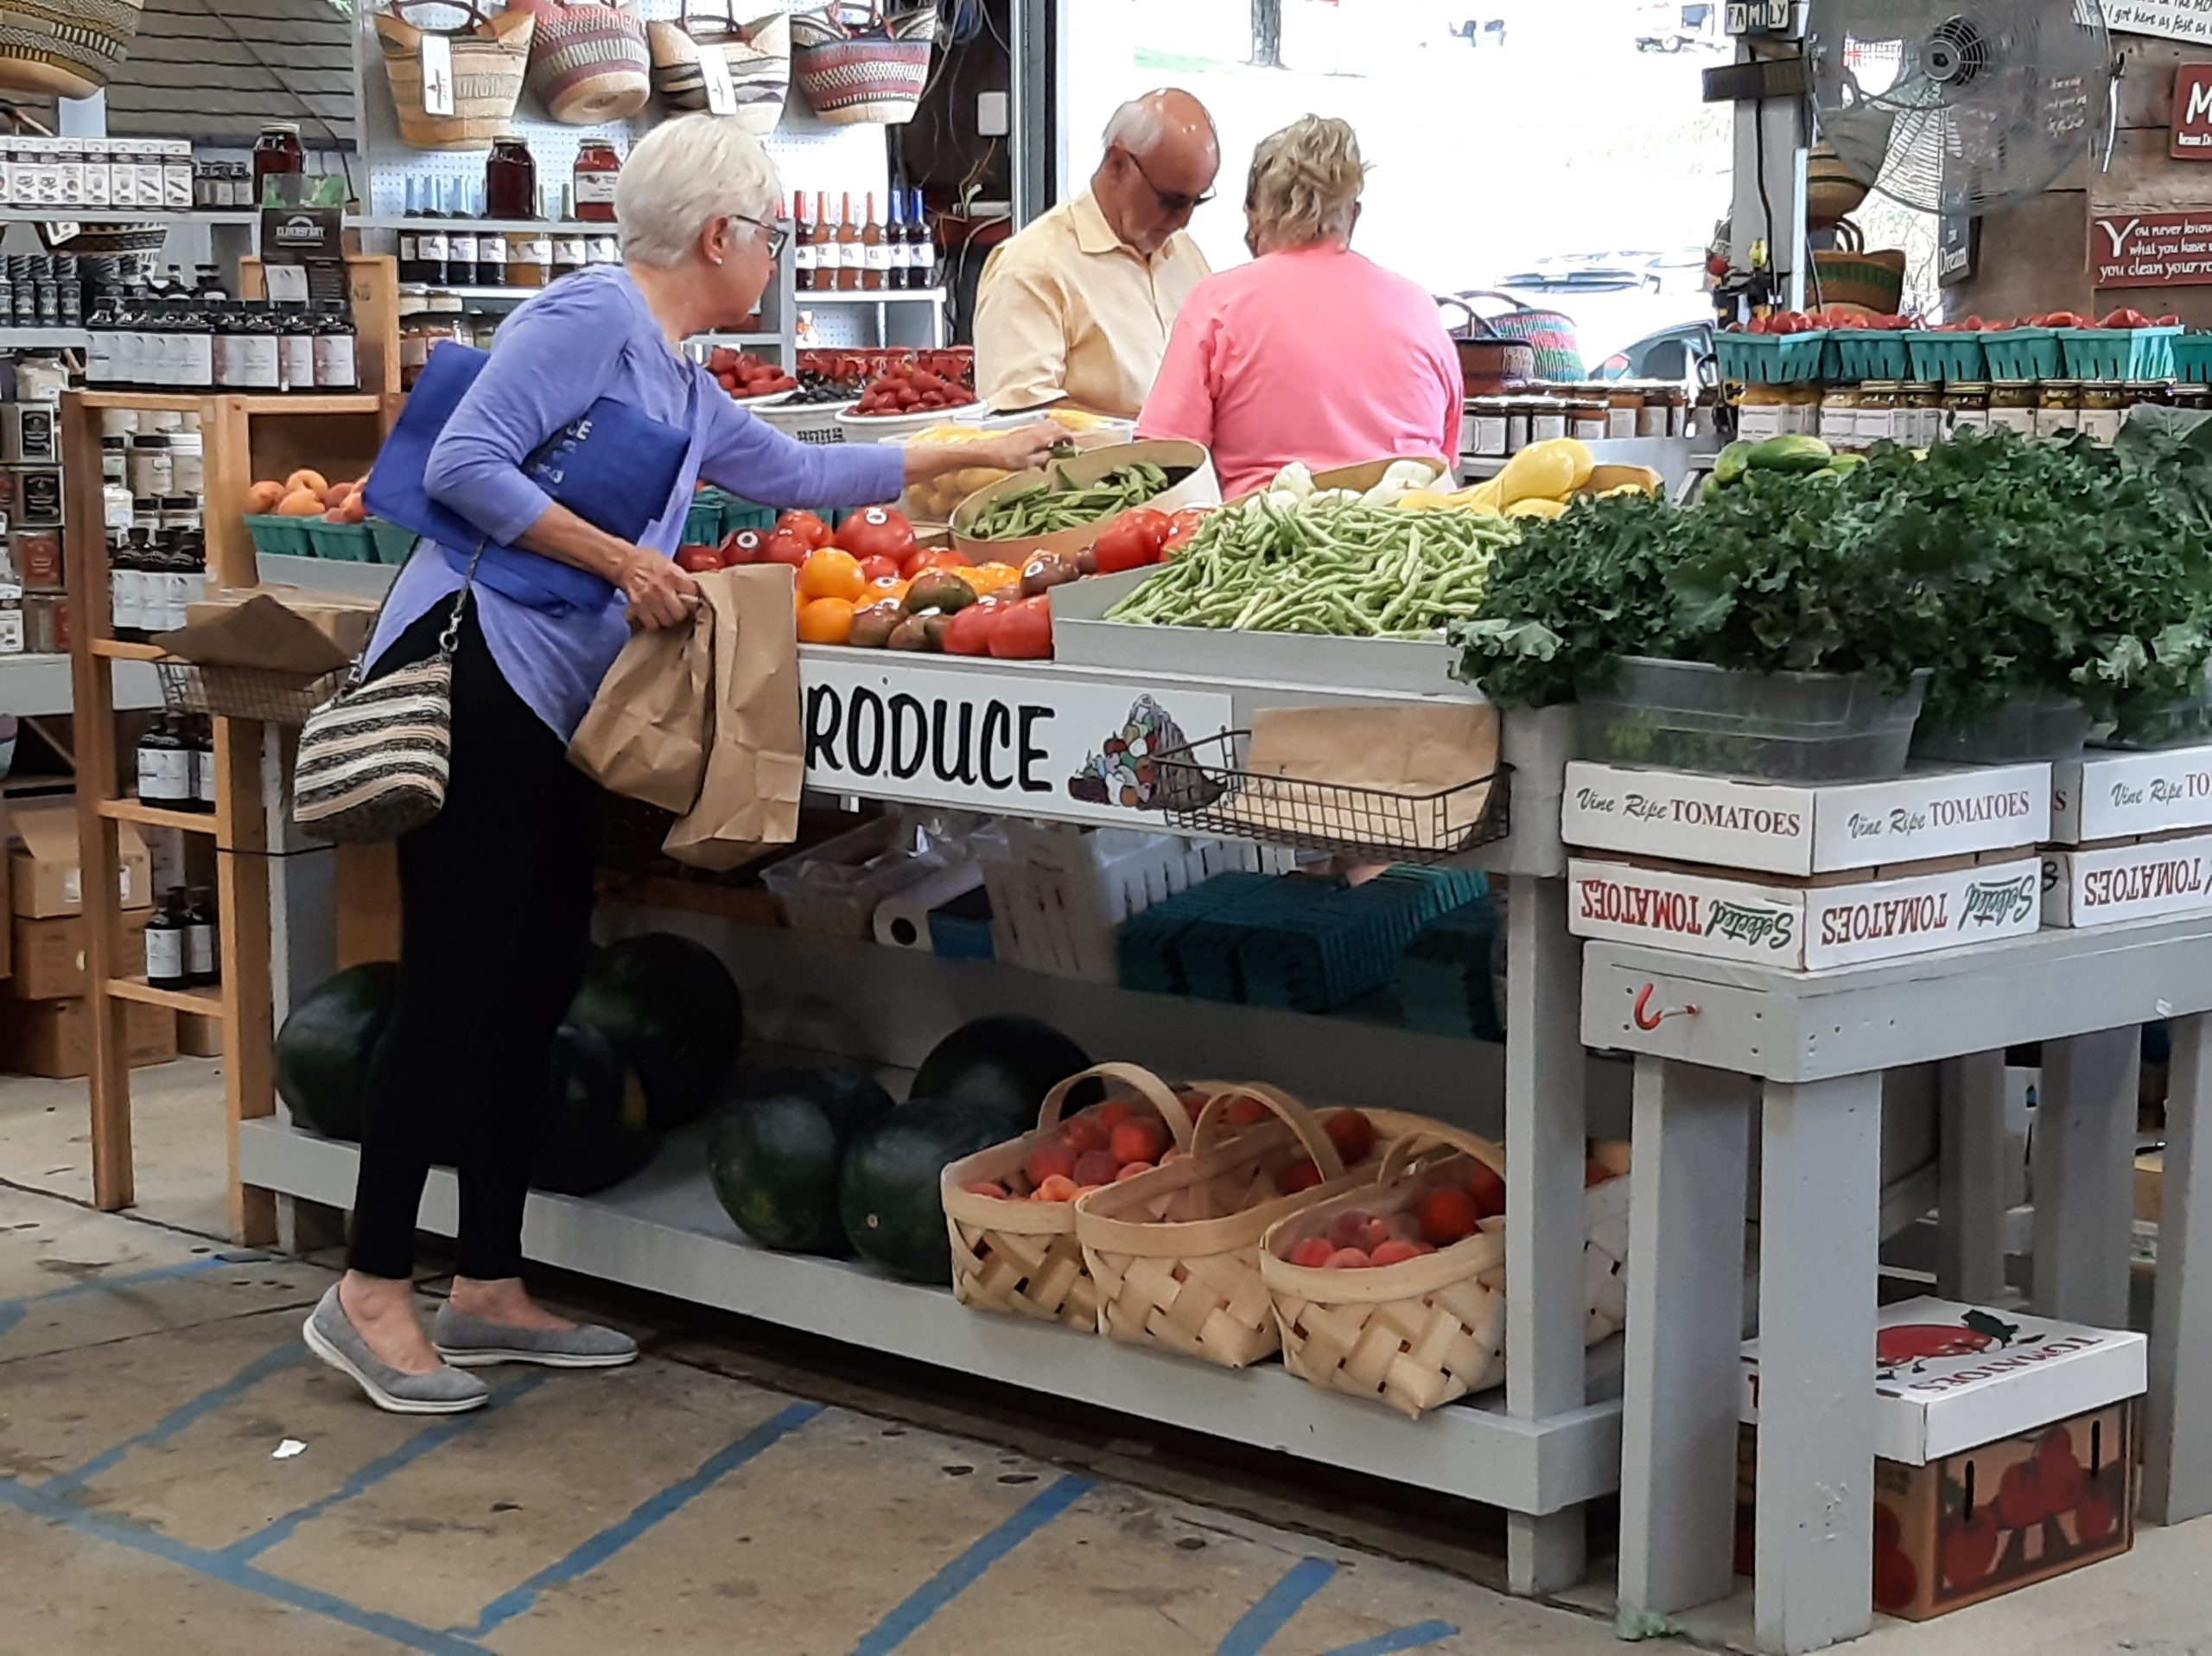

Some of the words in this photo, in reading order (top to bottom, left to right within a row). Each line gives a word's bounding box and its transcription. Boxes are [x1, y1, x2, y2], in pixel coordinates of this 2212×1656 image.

[1727, 3, 1786, 28] FAMILY
[2114, 6, 2132, 24] got
[2129, 239, 2157, 257] what
[2157, 243, 2178, 261] you
[2152, 225, 2183, 237] never
[1939, 246, 1967, 277] Dream
[2099, 264, 2125, 283] you
[2127, 257, 2164, 277] clean
[798, 683, 1055, 793] RODUCE
[1576, 787, 1614, 812] Vine
[1622, 793, 1668, 822] Ripe
[1670, 799, 1801, 837] TOMATOES
[1847, 812, 1882, 839] Vine
[1889, 808, 1926, 837] Ripe
[1929, 790, 2030, 827] TOMATOES
[2111, 782, 2143, 807] Vine
[2150, 779, 2183, 806] Ripe
[1957, 874, 2035, 931] Selected
[2084, 857, 2201, 907] TOMATOES
[1580, 879, 1702, 935] TOMATOES
[1705, 899, 1795, 950] Selected
[1821, 892, 1948, 946] TOMATOES
[1908, 1336, 2105, 1393] TOMATOES
